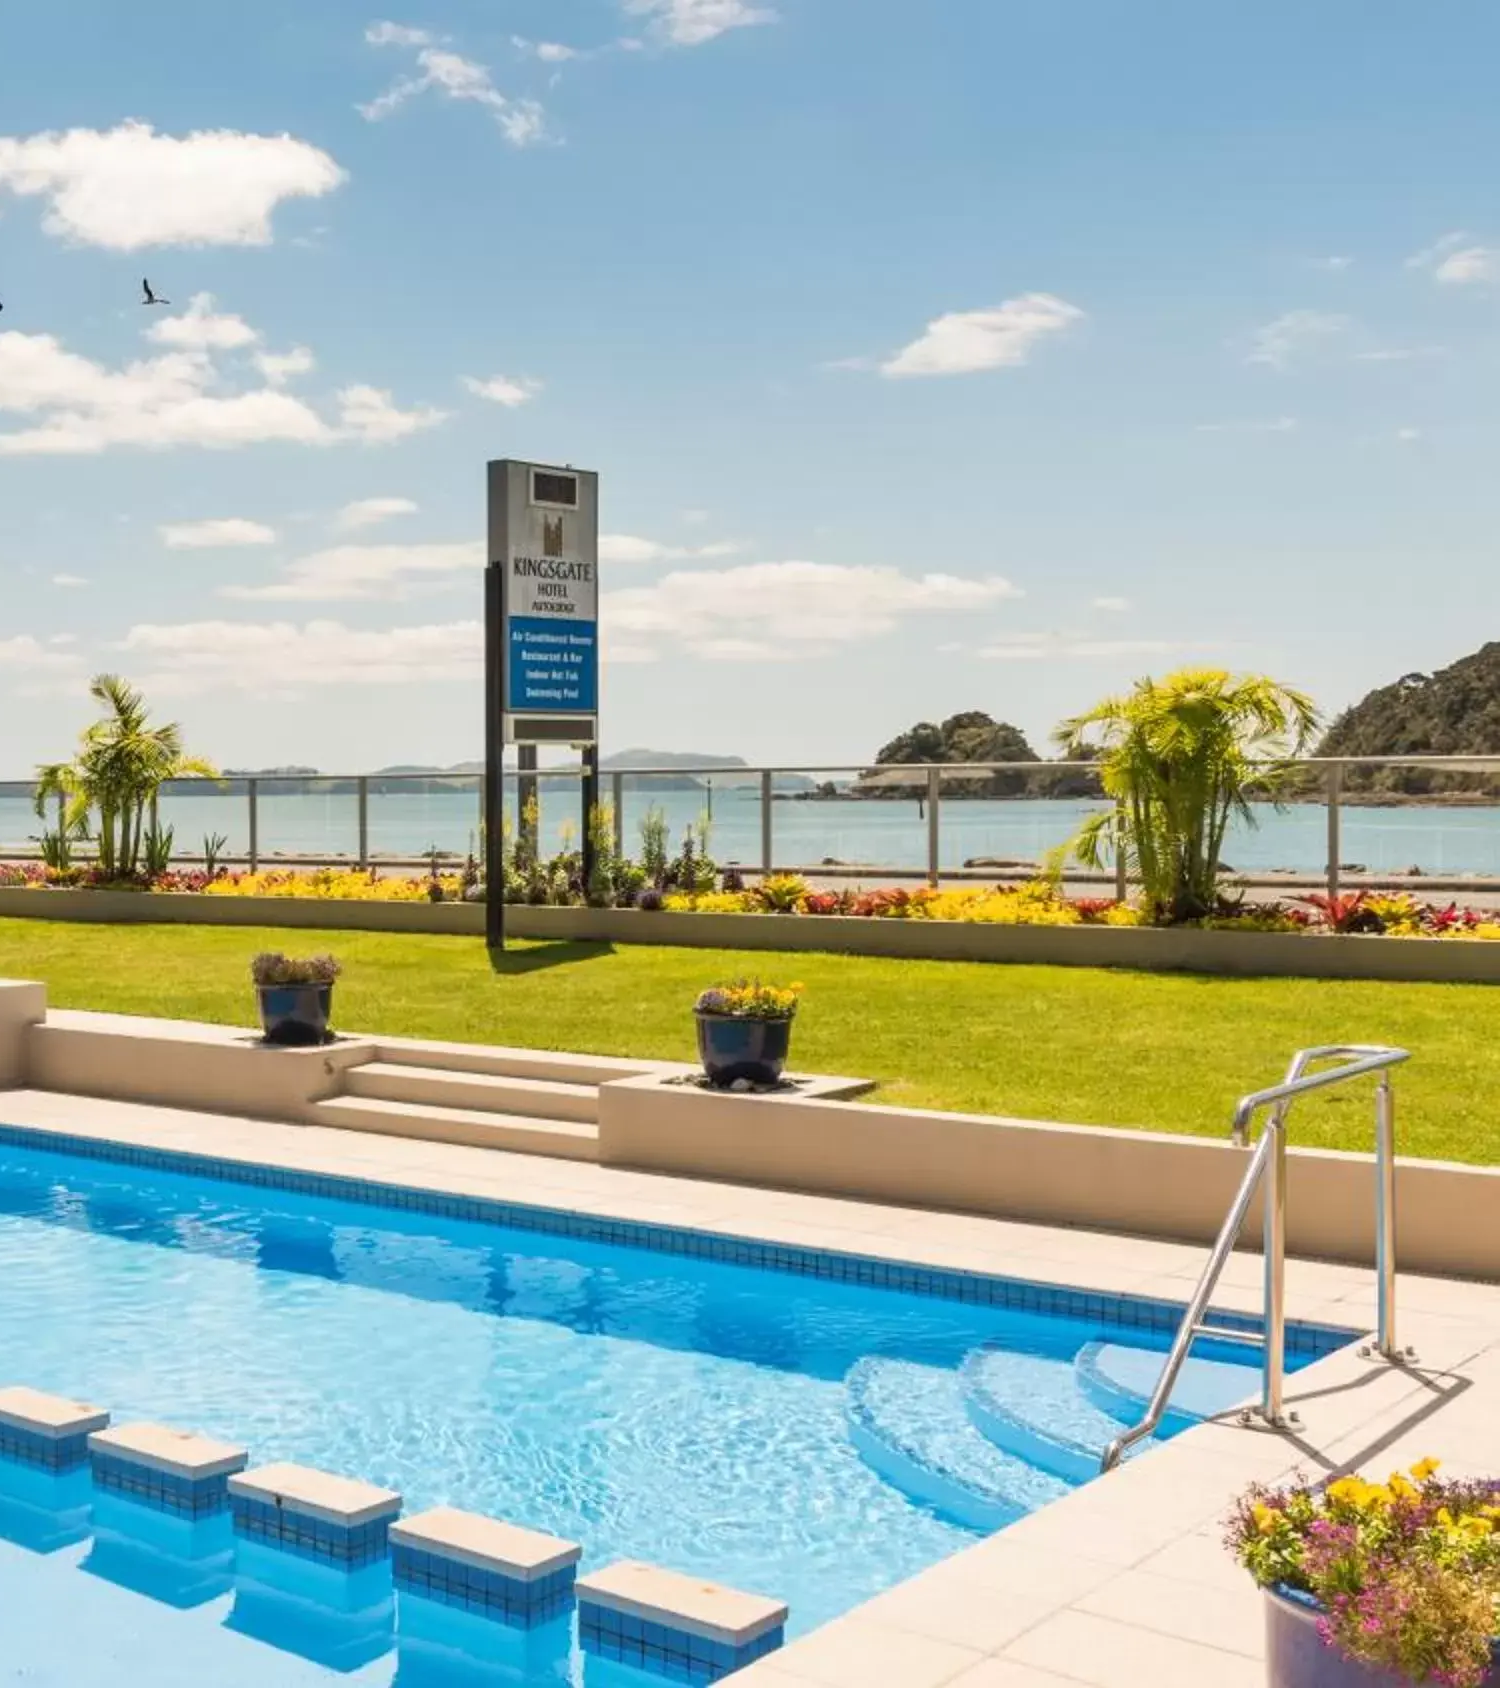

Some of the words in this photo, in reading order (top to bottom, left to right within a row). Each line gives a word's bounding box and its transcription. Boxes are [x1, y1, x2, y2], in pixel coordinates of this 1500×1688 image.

[513, 557, 593, 581] KINGSGATE
[537, 583, 568, 598] HOTEL
[521, 649, 560, 661] Restaurant
[570, 652, 583, 663] Bar
[525, 669, 548, 679] Indoor
[563, 688, 579, 699] Pool
